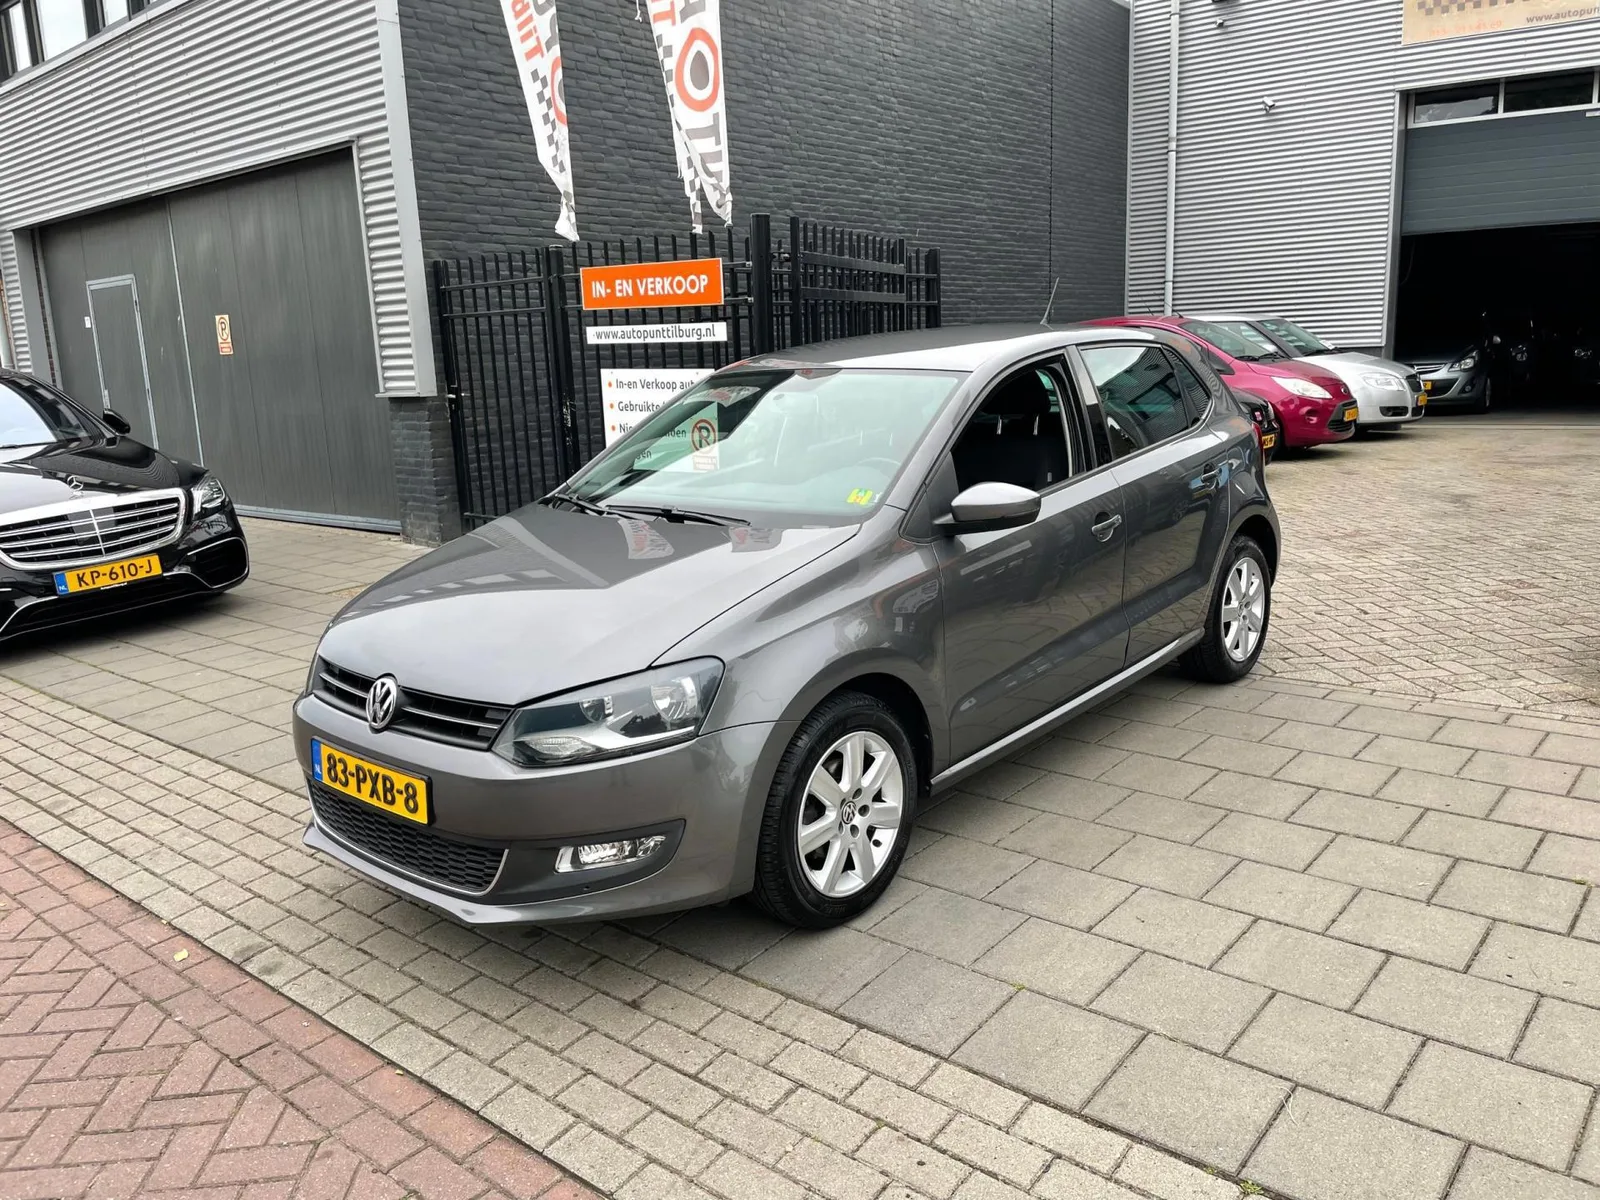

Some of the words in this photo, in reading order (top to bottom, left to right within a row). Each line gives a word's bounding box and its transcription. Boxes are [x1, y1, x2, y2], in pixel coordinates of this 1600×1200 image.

[591, 281, 611, 298] IN-
[615, 278, 633, 297] EN
[636, 274, 709, 296] VERKOOP
[595, 324, 716, 341] www.autopunttilburg.nl
[639, 378, 677, 392] Verkoop
[76, 559, 152, 588] KP-610-J
[326, 752, 419, 814] 83-PXB-8
